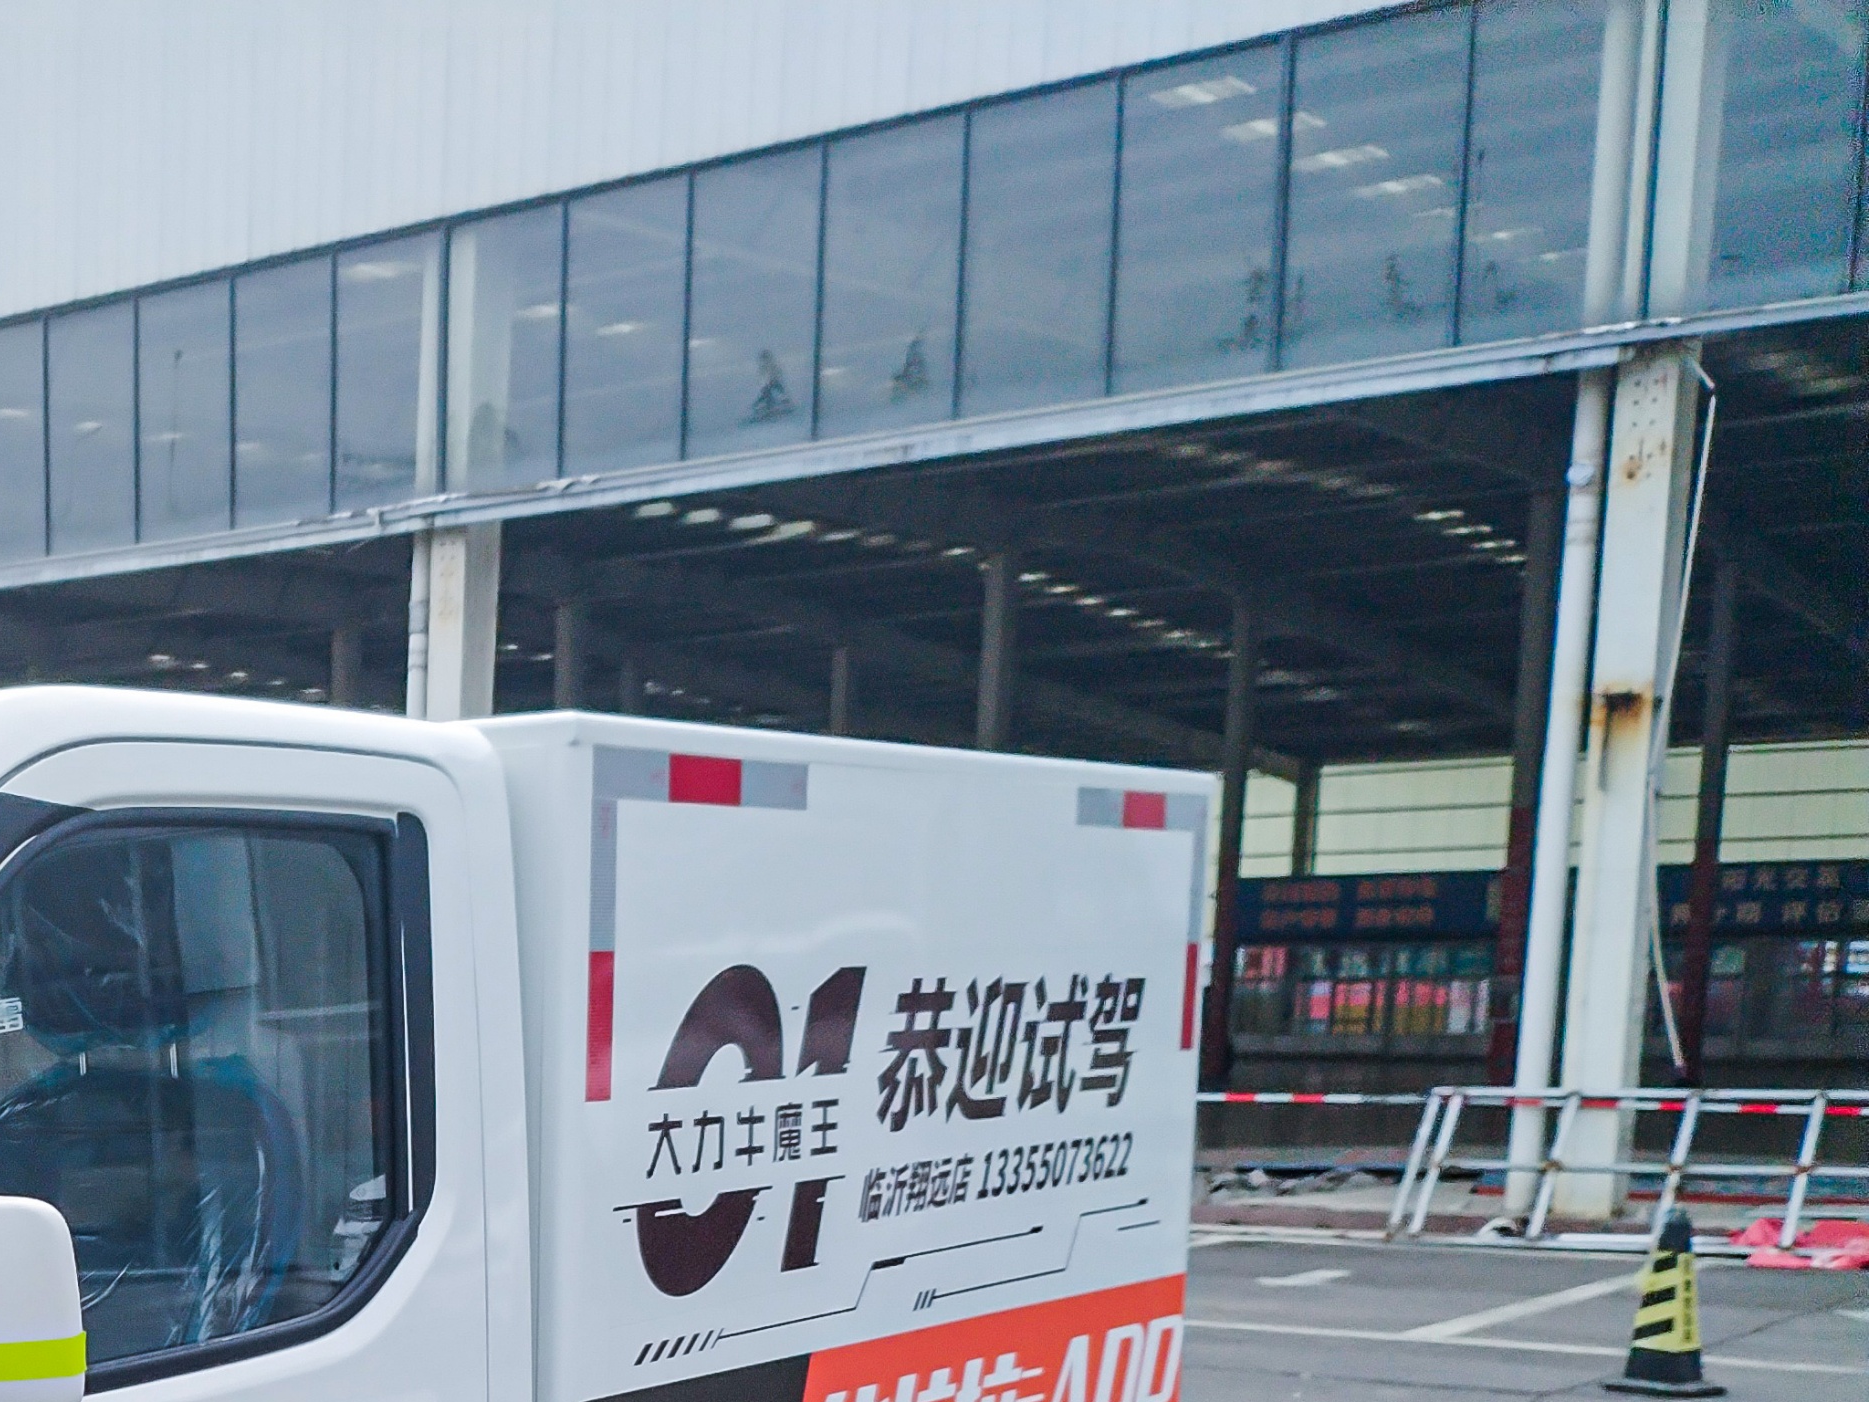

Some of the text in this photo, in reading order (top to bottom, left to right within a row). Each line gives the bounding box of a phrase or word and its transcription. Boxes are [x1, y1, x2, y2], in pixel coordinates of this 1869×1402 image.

[877, 973, 1146, 1133] 恭迎试驾
[646, 1098, 840, 1179] 大力牛魔王
[858, 1131, 1134, 1223] 临沂翔远店 13355073622
